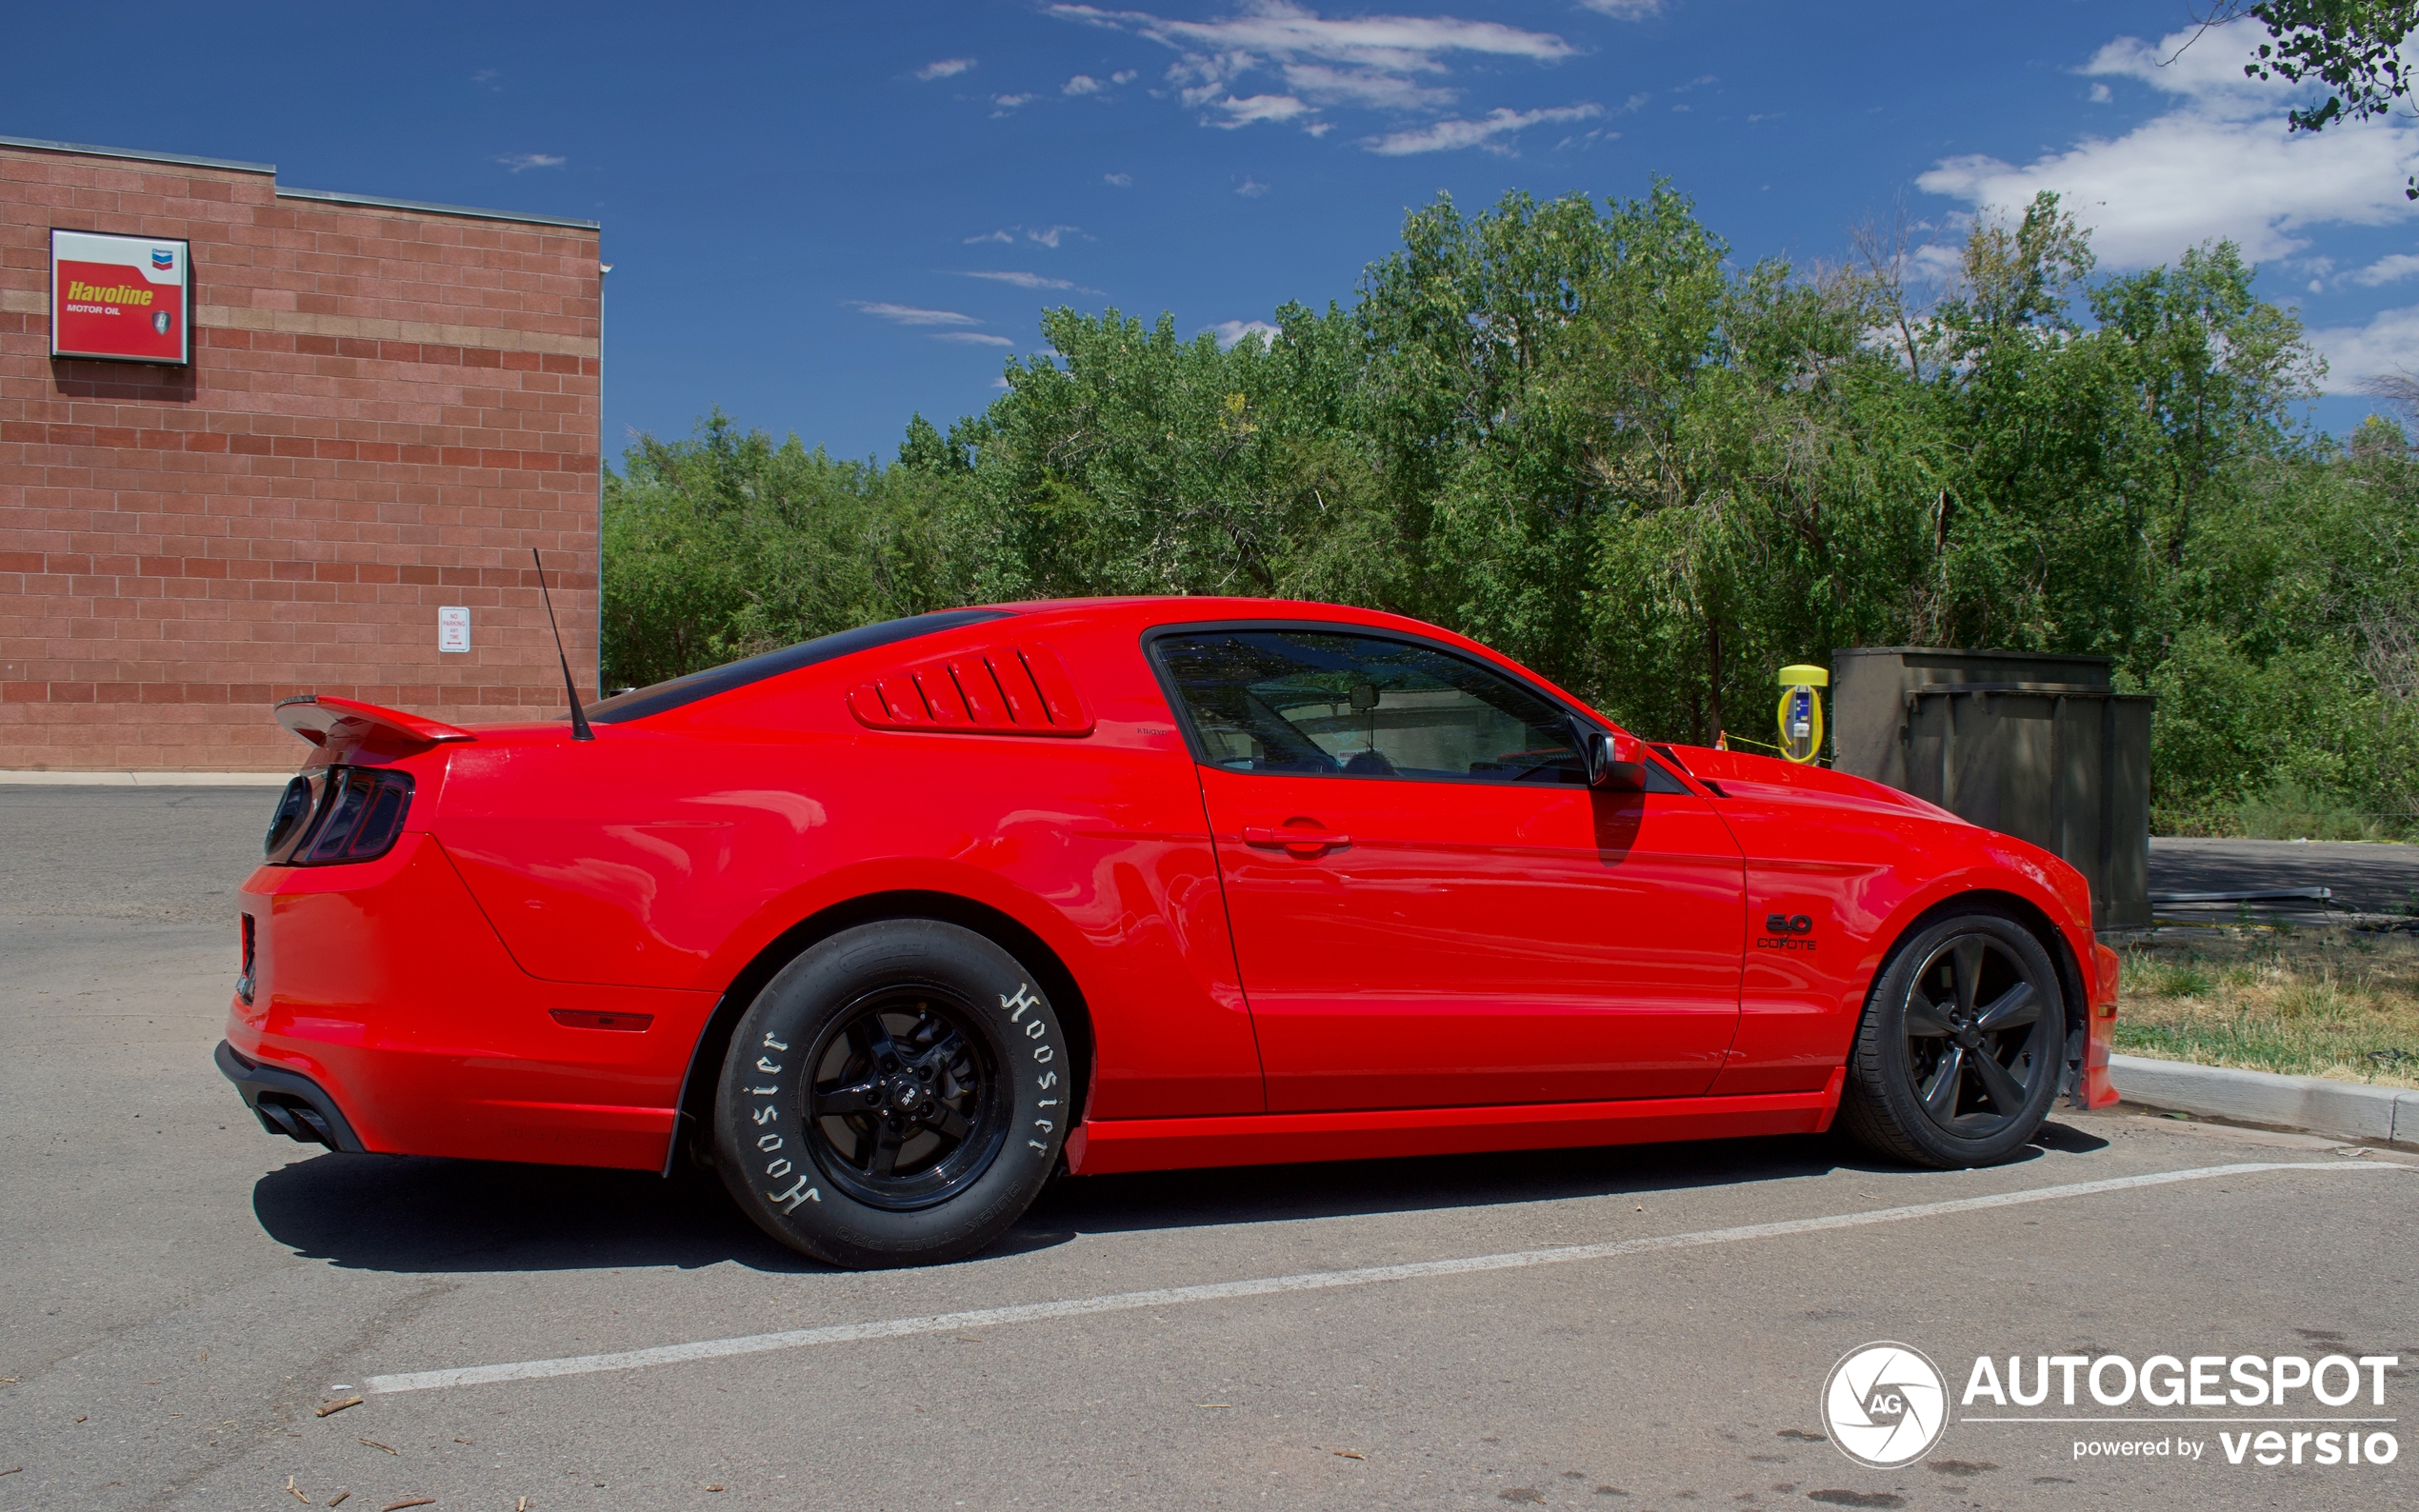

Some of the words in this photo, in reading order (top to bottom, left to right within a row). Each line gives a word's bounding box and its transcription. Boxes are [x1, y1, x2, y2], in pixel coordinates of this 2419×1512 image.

[68, 281, 153, 306] Havoline
[67, 304, 103, 314] MOTOR
[105, 307, 121, 315] OIL
[1766, 913, 1812, 932] 5.0
[1757, 937, 1817, 950] COYOTE
[998, 982, 1066, 1159] Hoosier
[741, 1030, 821, 1217] Hoosier
[835, 1223, 885, 1253] PRO
